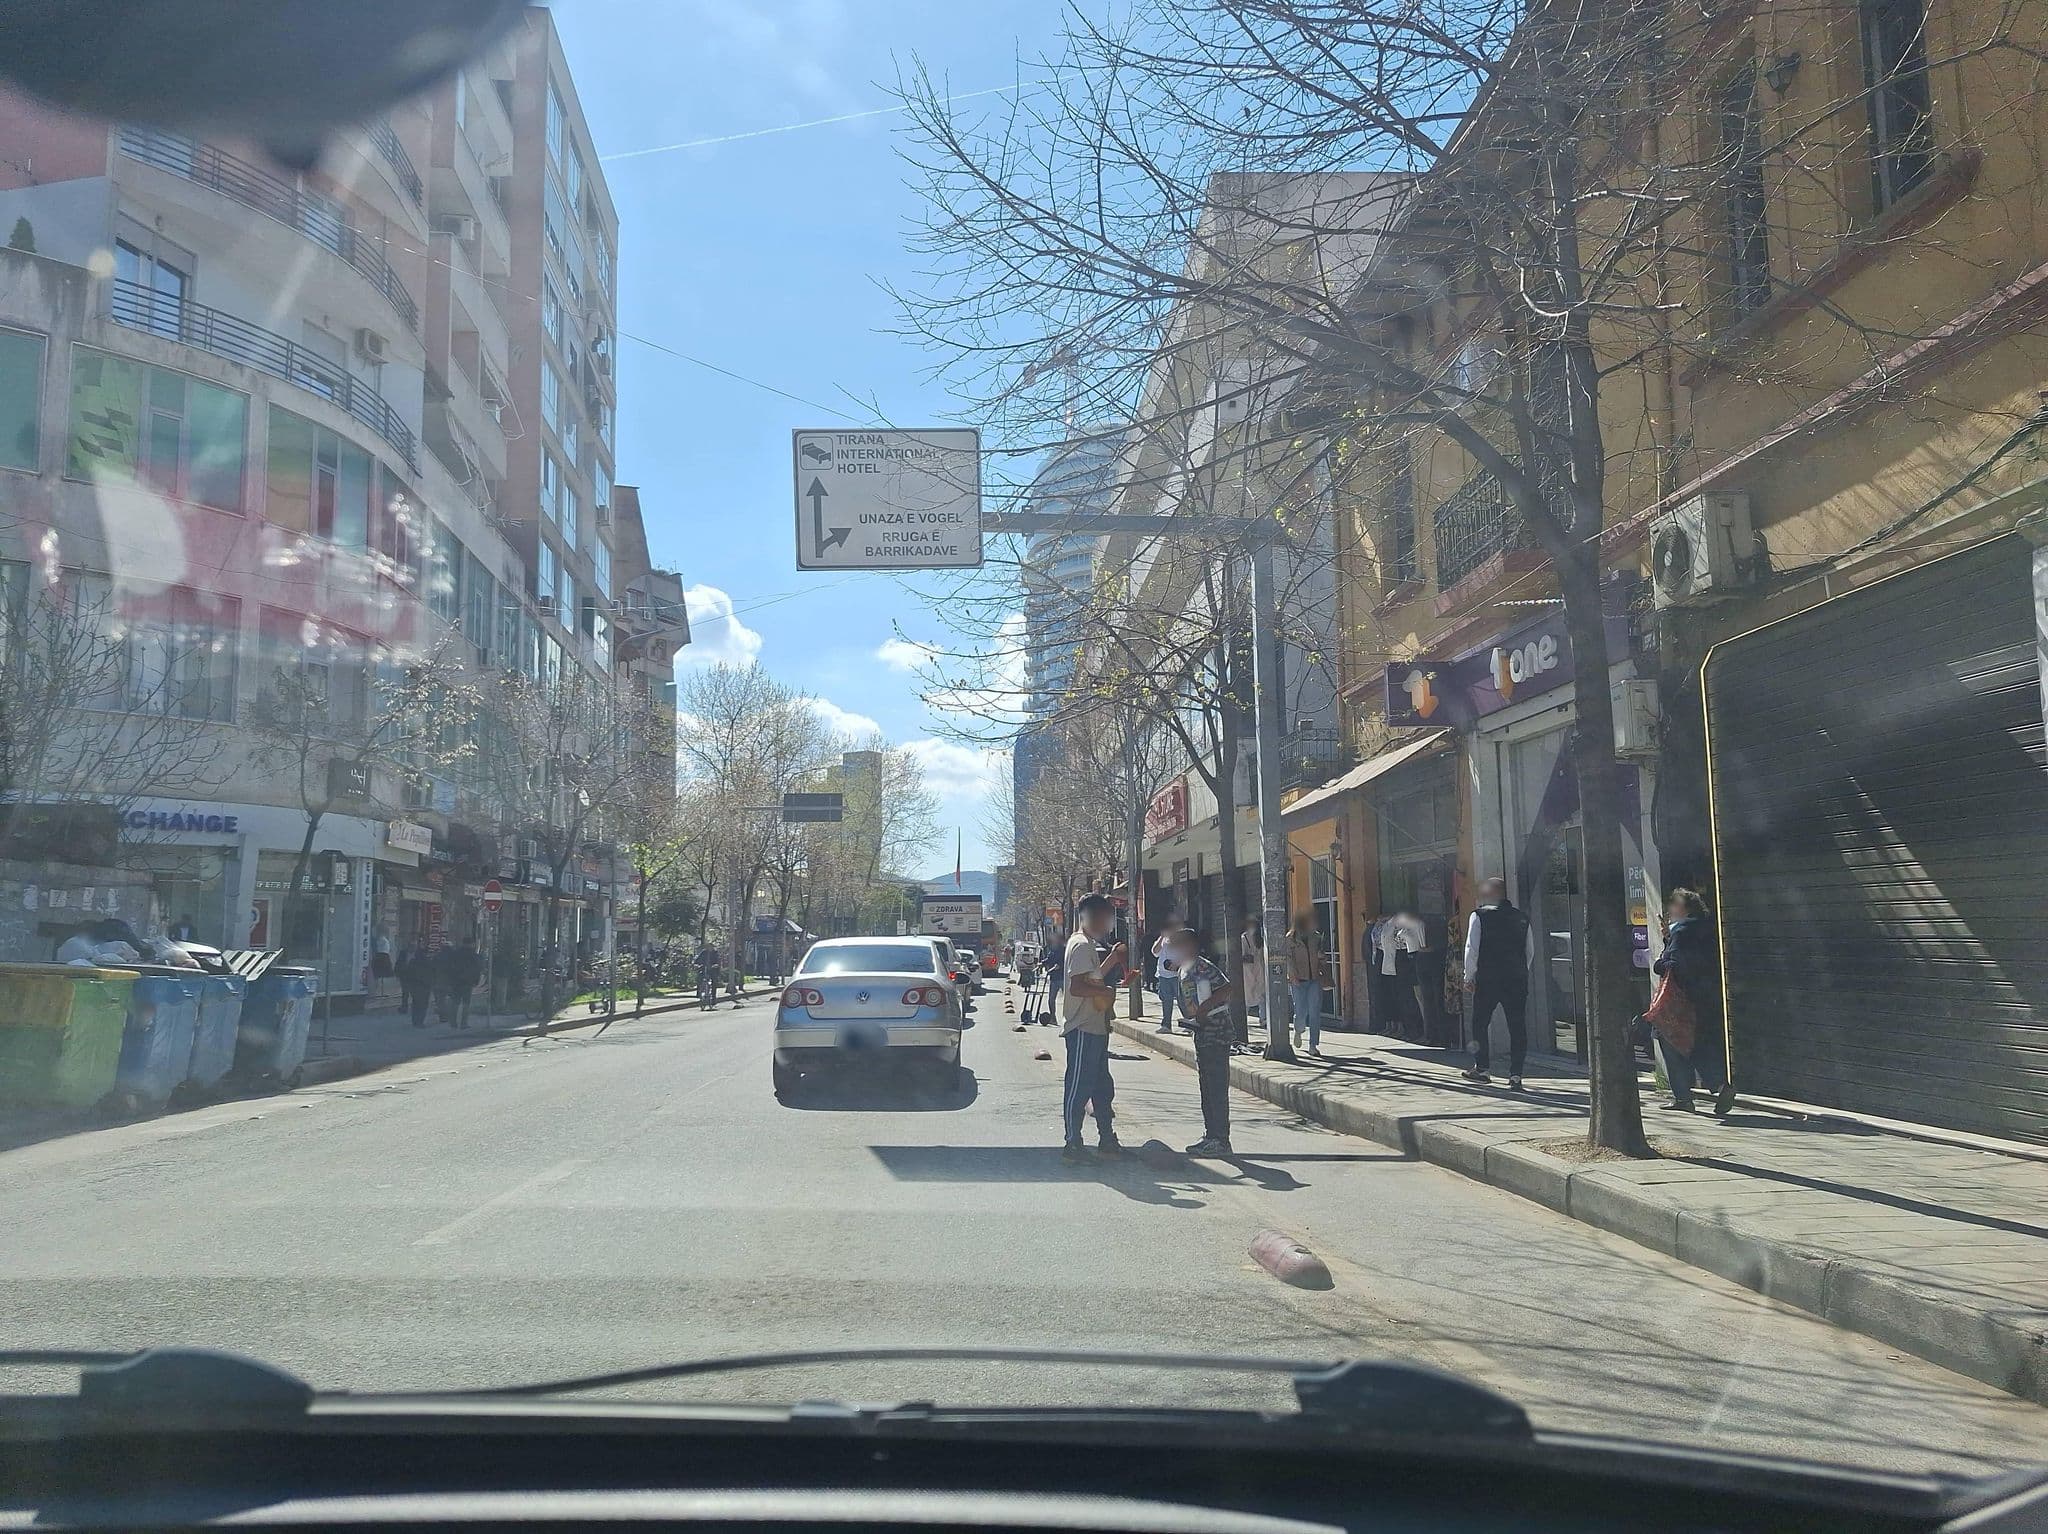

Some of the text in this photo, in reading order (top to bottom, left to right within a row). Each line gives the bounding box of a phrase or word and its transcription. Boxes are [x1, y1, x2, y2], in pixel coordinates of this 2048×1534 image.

[836, 434, 884, 445] TIRANA
[837, 448, 939, 460] INTERNATIONAL
[837, 463, 881, 474] HOTEL
[859, 512, 963, 524] UNAZA E VOGEL
[882, 531, 929, 542] RRUGA
[865, 545, 958, 556] BARRIKADAVE
[936, 905, 963, 913] ZDRAVA
